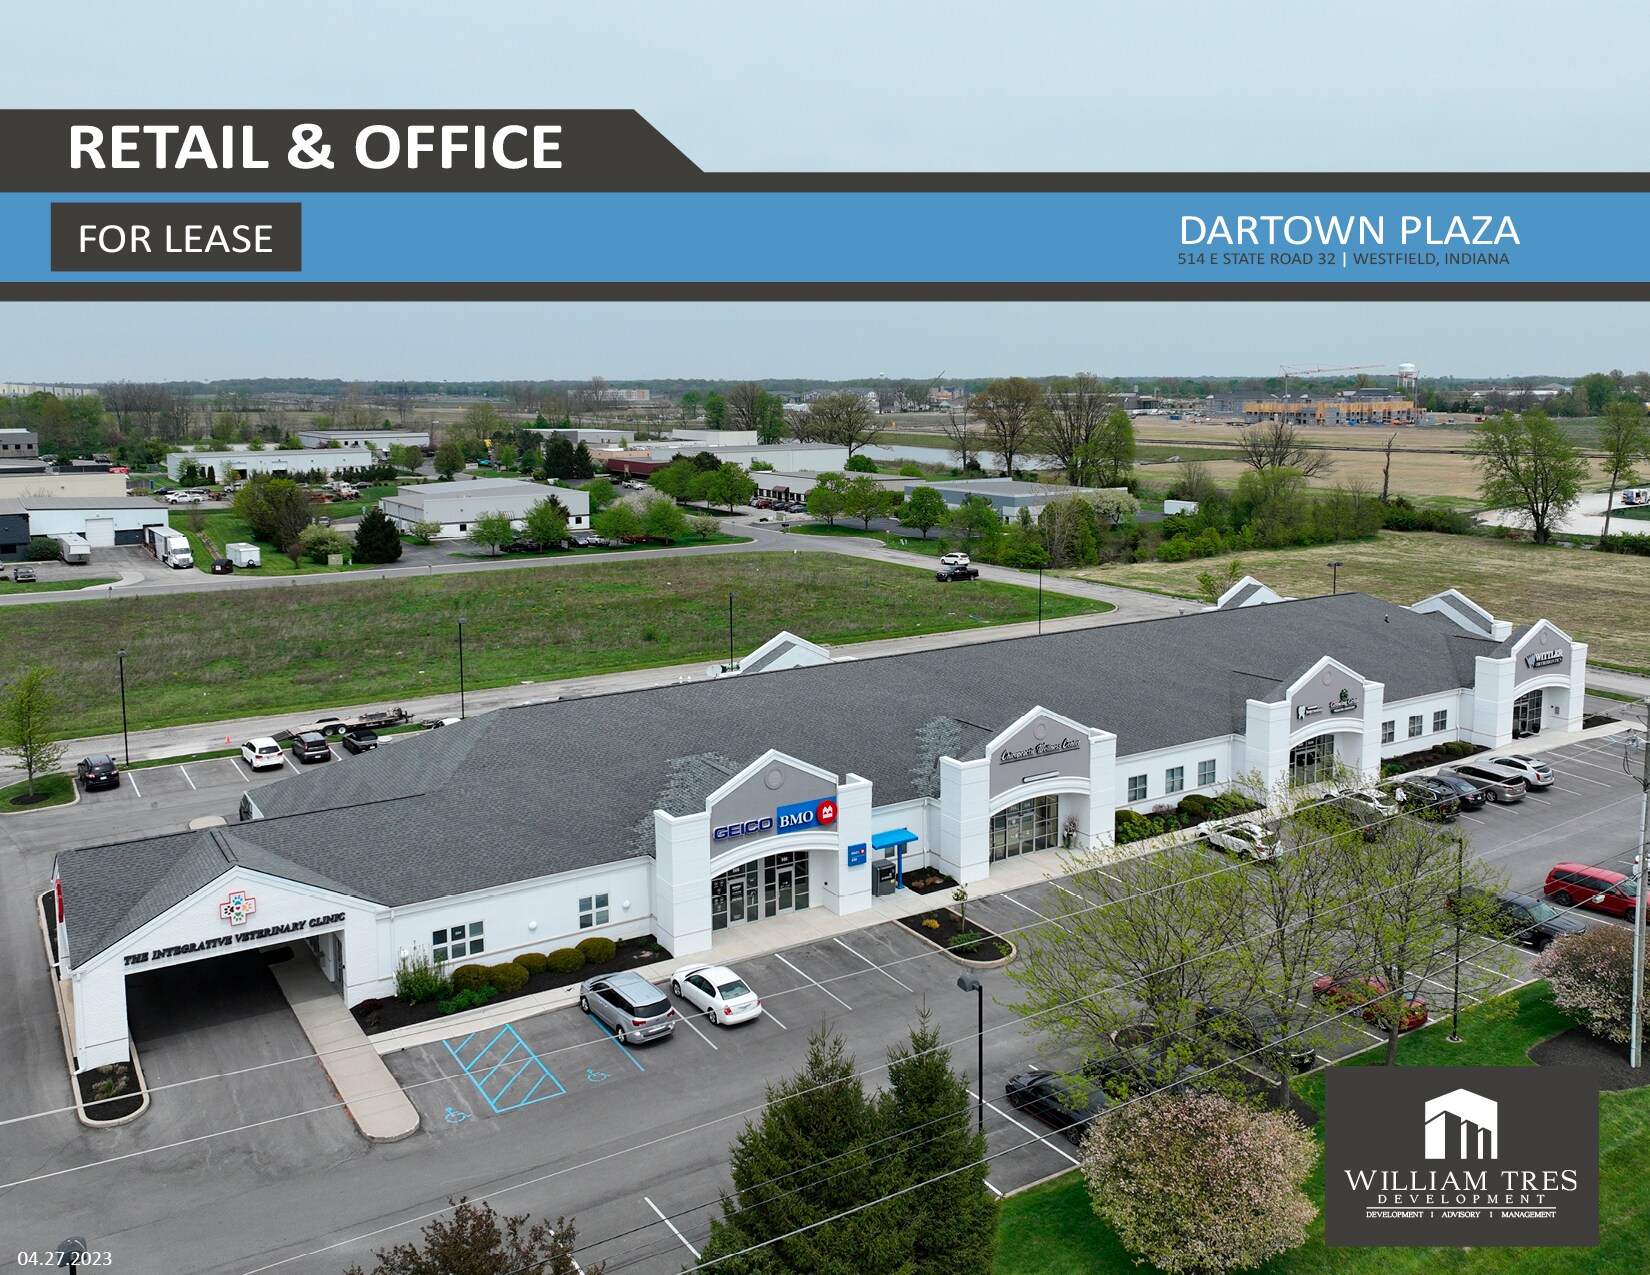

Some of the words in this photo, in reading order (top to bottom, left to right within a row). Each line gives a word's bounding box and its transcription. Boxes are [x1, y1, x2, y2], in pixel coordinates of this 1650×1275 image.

[1535, 649, 1564, 661] WITTLER
[713, 817, 773, 841] GEICO
[779, 810, 814, 828] BMO
[124, 953, 149, 966] THE
[152, 935, 233, 960] INTEGRATIVE
[235, 920, 306, 943] VETERINARY
[308, 912, 346, 928] CLINIC
